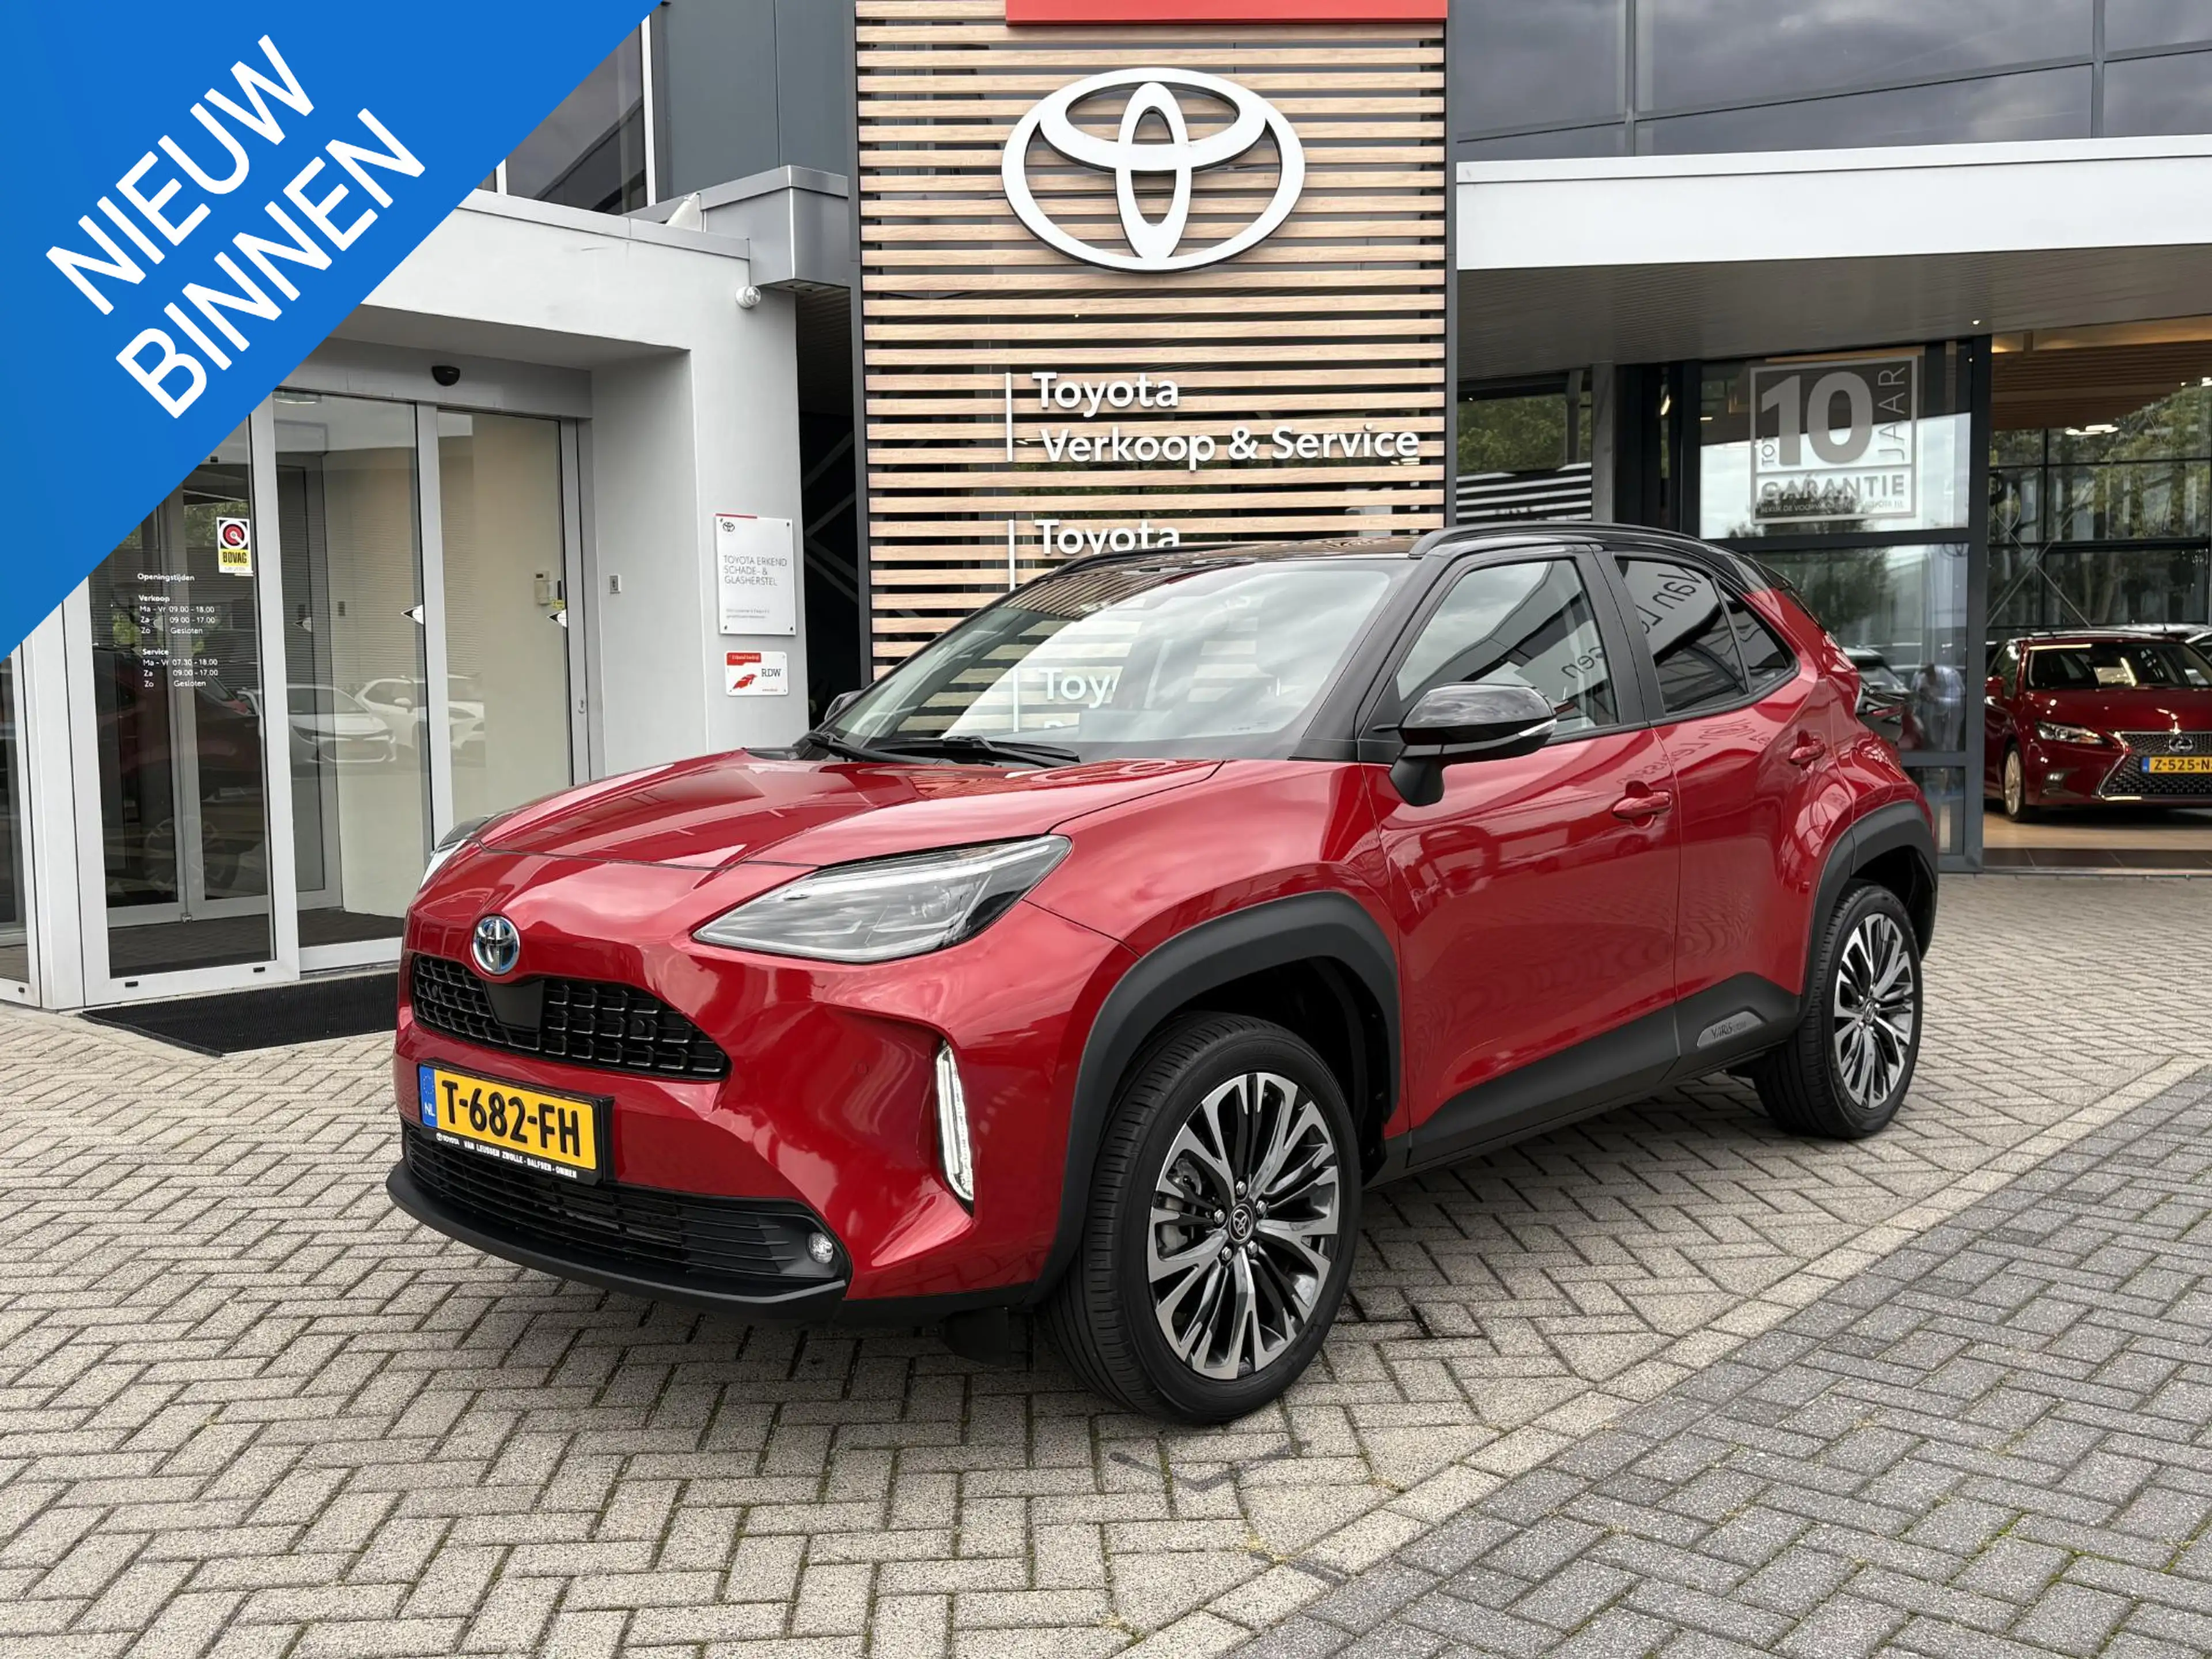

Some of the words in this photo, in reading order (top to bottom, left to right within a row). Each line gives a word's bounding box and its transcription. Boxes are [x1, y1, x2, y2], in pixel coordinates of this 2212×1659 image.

[1032, 372, 1179, 418] Toyota
[1762, 372, 1873, 467] 10
[1877, 366, 1906, 461] JAAR
[1040, 426, 1215, 473] Verkoop
[1228, 426, 1259, 460] &
[1271, 423, 1420, 459] Service
[1762, 475, 1904, 501] GARANTIE
[1035, 518, 1181, 555] Toyota
[222, 551, 247, 563] BOVAG
[724, 555, 755, 565] TOYOTA
[756, 556, 787, 566] ERKEND
[137, 573, 195, 582] Openingstijden
[725, 576, 778, 586] GLASHERSTEL
[138, 594, 170, 603] Verkoop
[761, 668, 782, 677] RDW
[1038, 668, 1122, 709] Toy
[2154, 759, 2212, 771] Z-525-N
[423, 1103, 436, 1117] NL
[441, 1080, 581, 1158] T-682-FH
[463, 1140, 475, 1150] VAN
[502, 1151, 524, 1164] ZWOLLE
